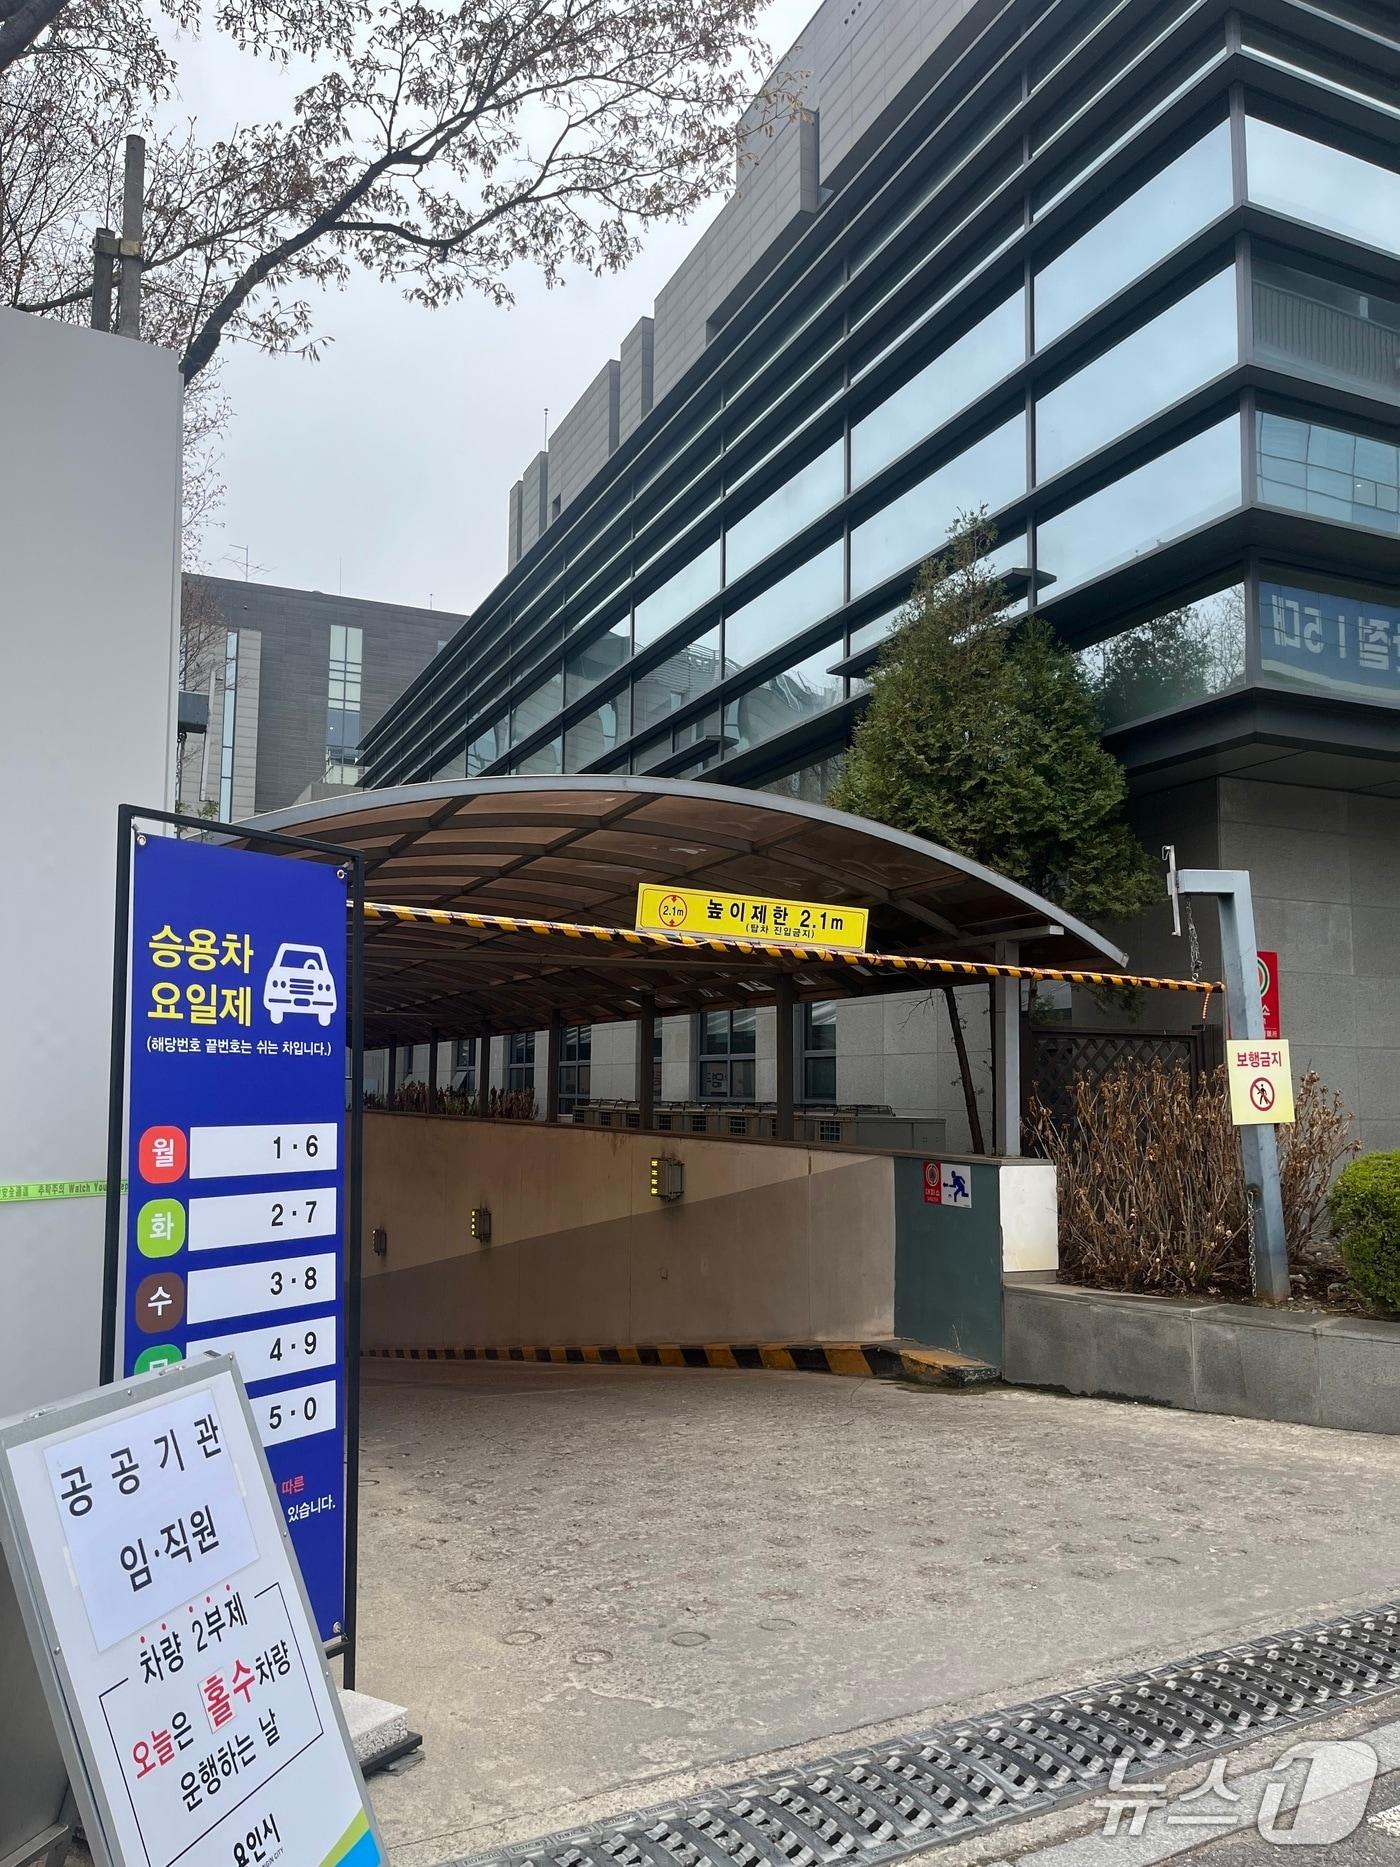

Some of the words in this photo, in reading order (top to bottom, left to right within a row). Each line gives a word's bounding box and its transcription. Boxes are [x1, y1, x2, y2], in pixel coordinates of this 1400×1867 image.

[662, 905, 684, 917] 2.1m
[706, 899, 788, 927] 높이제한
[799, 909, 844, 931] 2.1m
[745, 923, 769, 935] (탑차
[773, 925, 815, 939] 진입금지)
[148, 925, 254, 974] 승용차
[147, 982, 252, 1027] 요일제
[146, 1035, 201, 1054] (해당번호
[205, 1037, 252, 1055] 끝번호는
[256, 1040, 279, 1055] 쉬는
[282, 1040, 332, 1057] 차입니다.)
[1236, 1051, 1282, 1068] 보행금지
[152, 1138, 174, 1168] 월
[94, 1182, 107, 1193] You
[150, 1211, 175, 1240] 화
[148, 1286, 173, 1316] 수
[281, 1475, 305, 1494] 따른
[287, 1494, 336, 1523] 있습니다.
[140, 1631, 184, 1684] 차량
[192, 1592, 248, 1653] 2부제
[132, 1711, 194, 1779] 오늘은
[180, 1734, 256, 1812] 운행하는
[258, 1708, 281, 1747] 날
